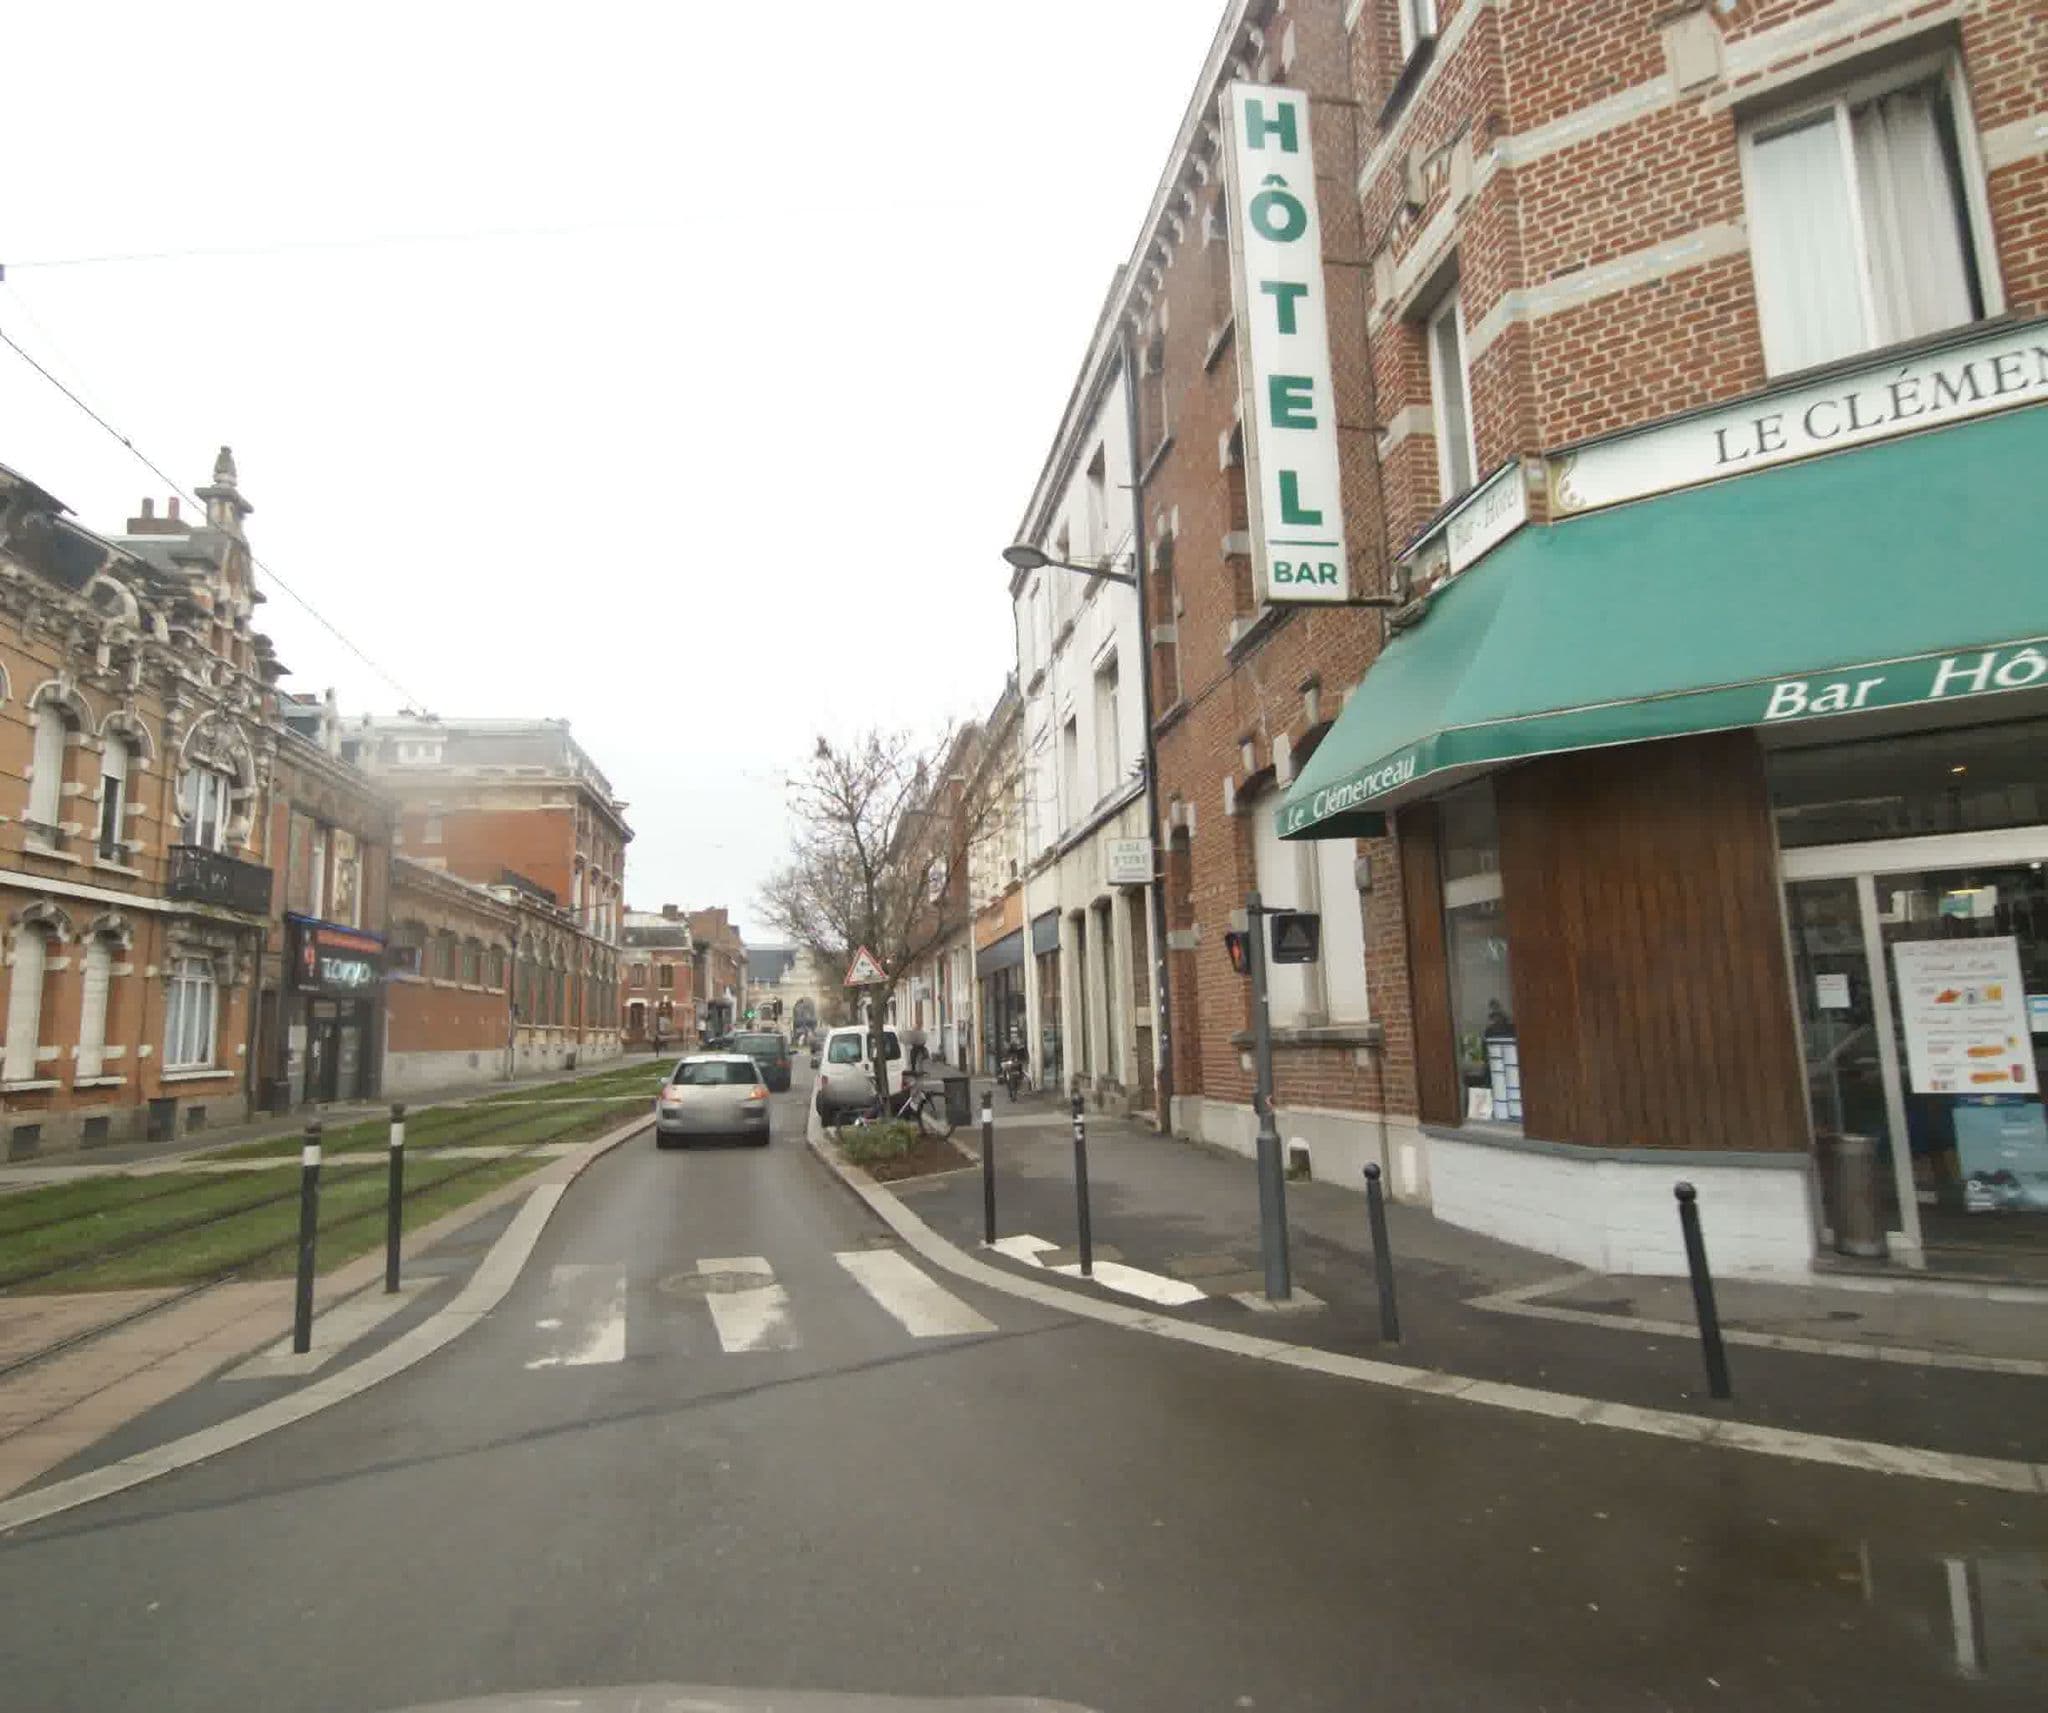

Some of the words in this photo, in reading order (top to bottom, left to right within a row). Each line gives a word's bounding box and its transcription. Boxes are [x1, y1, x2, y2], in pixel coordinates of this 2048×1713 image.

[1244, 98, 1323, 527] HÔTEL
[1714, 414, 1788, 464] LE
[1273, 561, 1338, 585] BAR
[1762, 676, 1887, 720] Bar
[1928, 647, 2048, 698] Hô
[1287, 805, 1305, 831] Le
